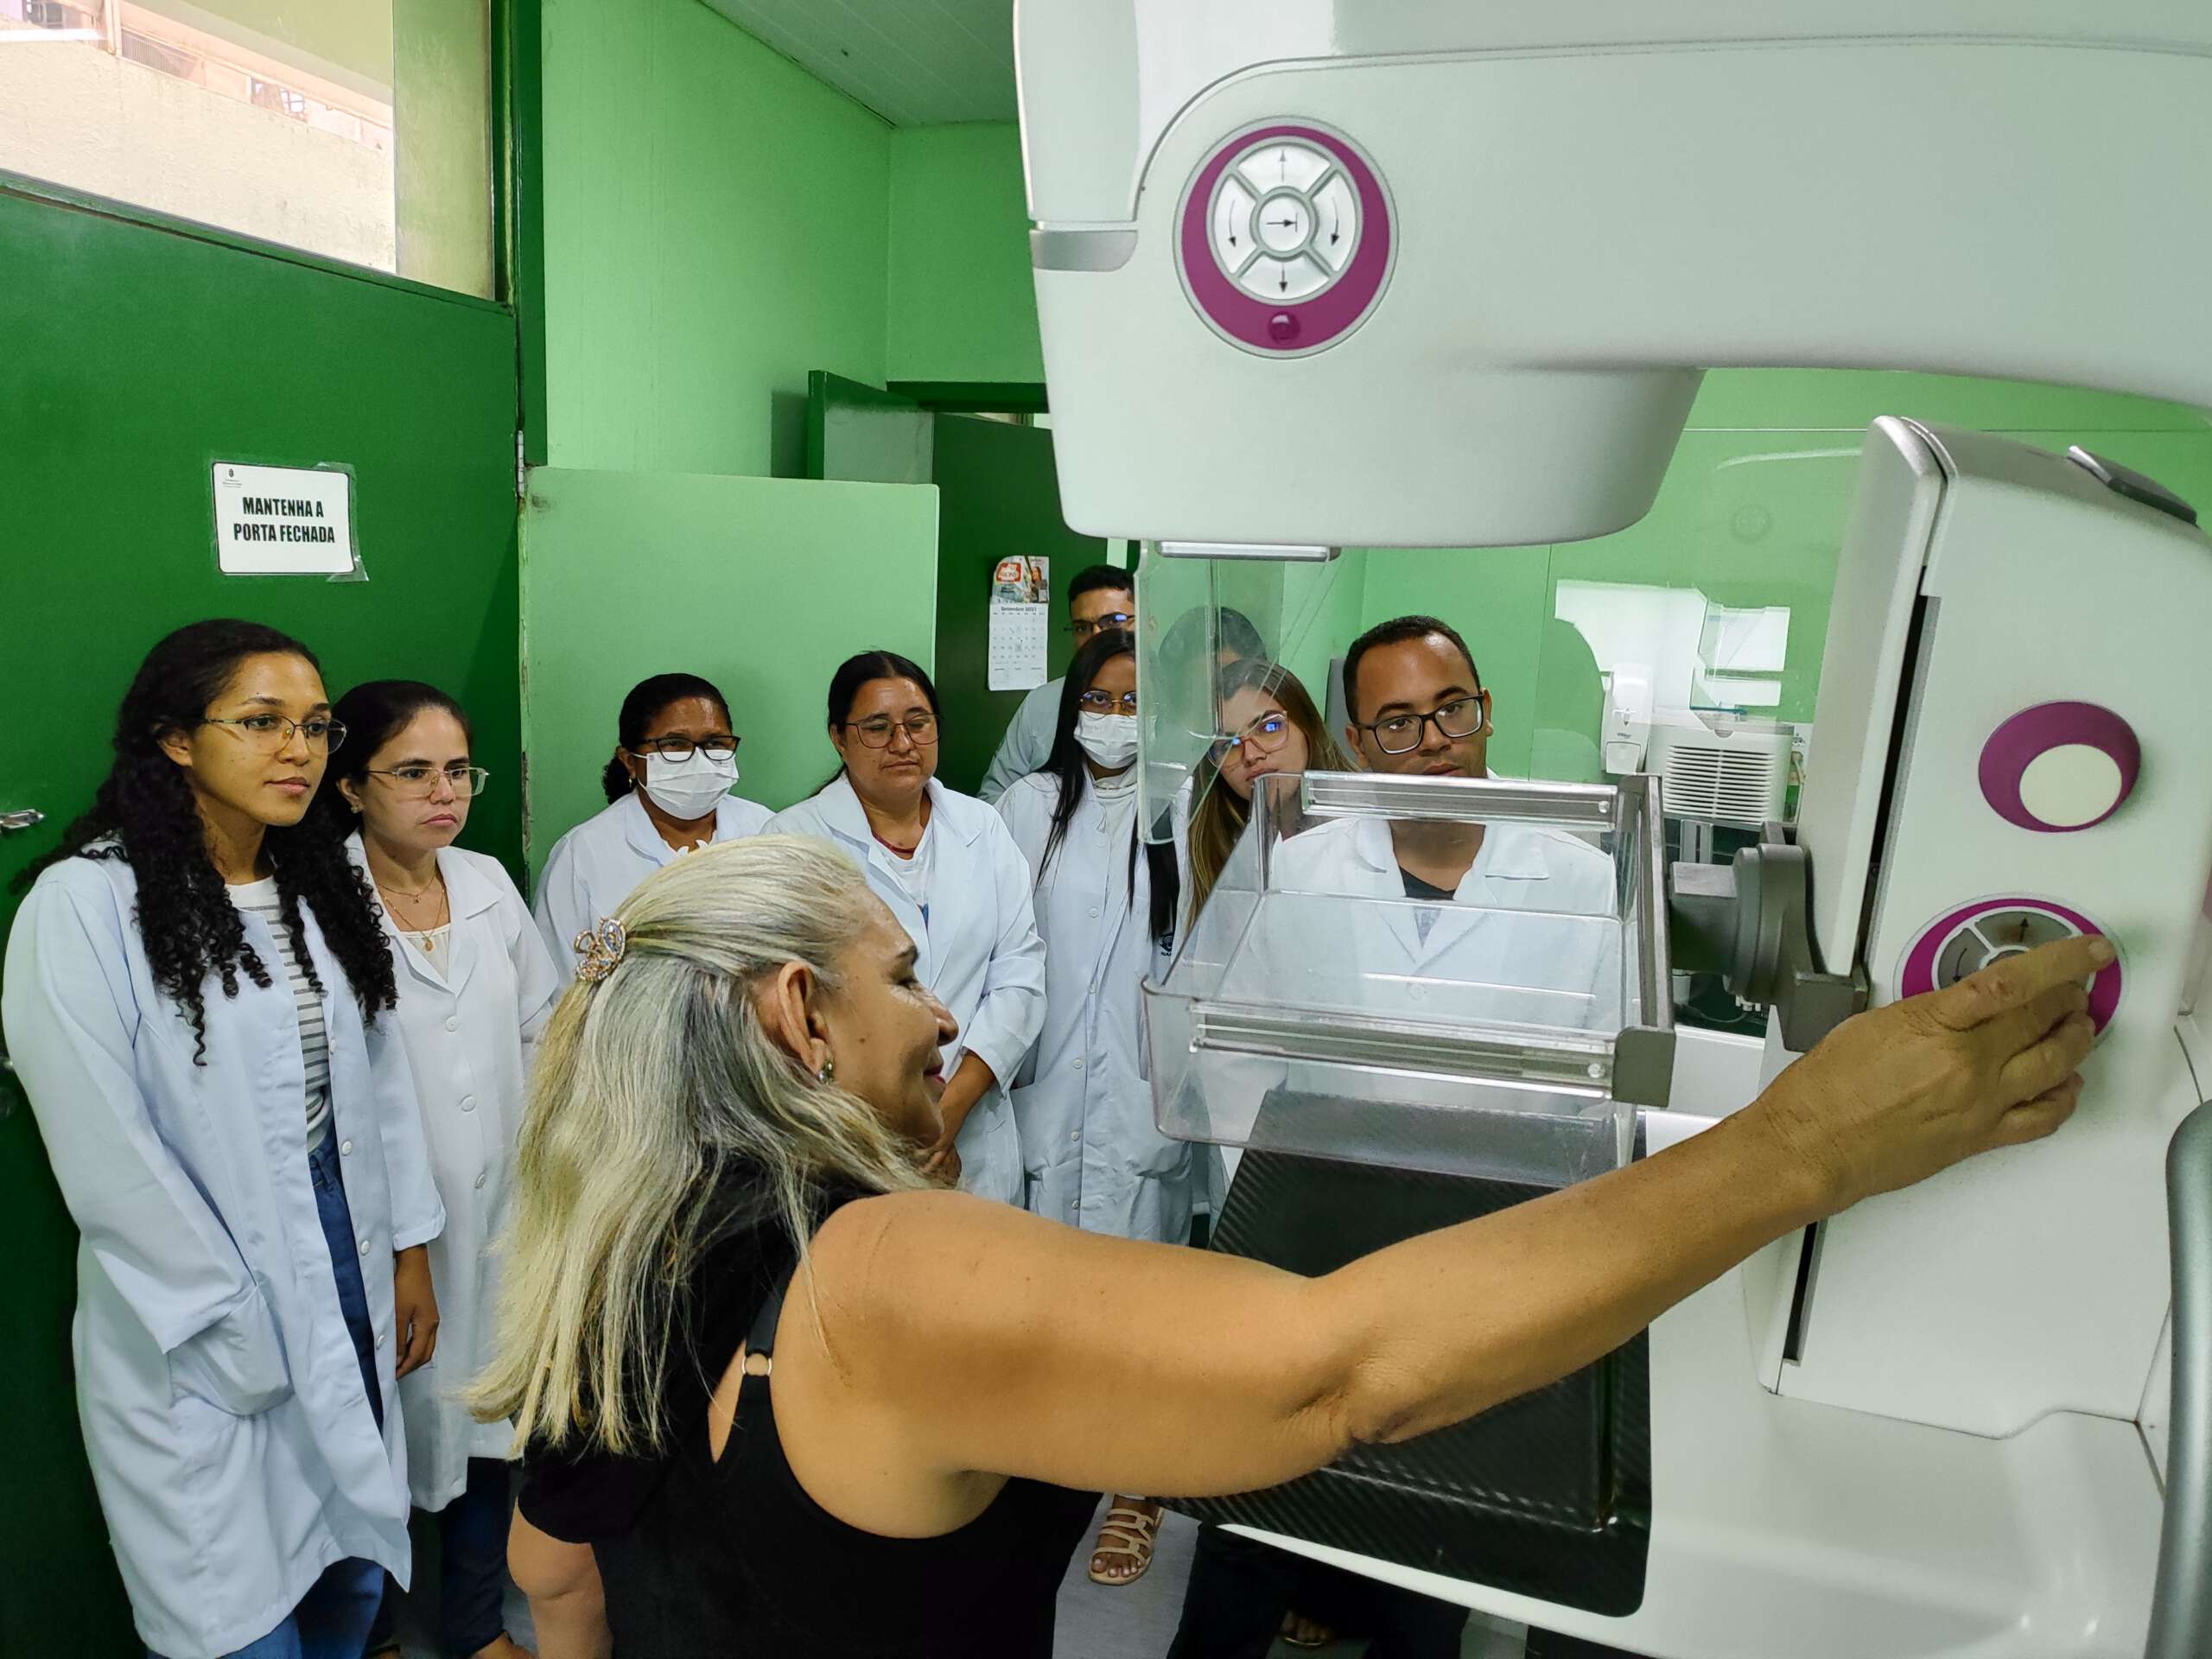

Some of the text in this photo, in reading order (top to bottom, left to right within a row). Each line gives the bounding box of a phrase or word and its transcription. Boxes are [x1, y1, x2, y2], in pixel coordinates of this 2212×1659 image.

[242, 496, 325, 518] MANTENHA A
[233, 523, 335, 543] PORTA FECHADA
